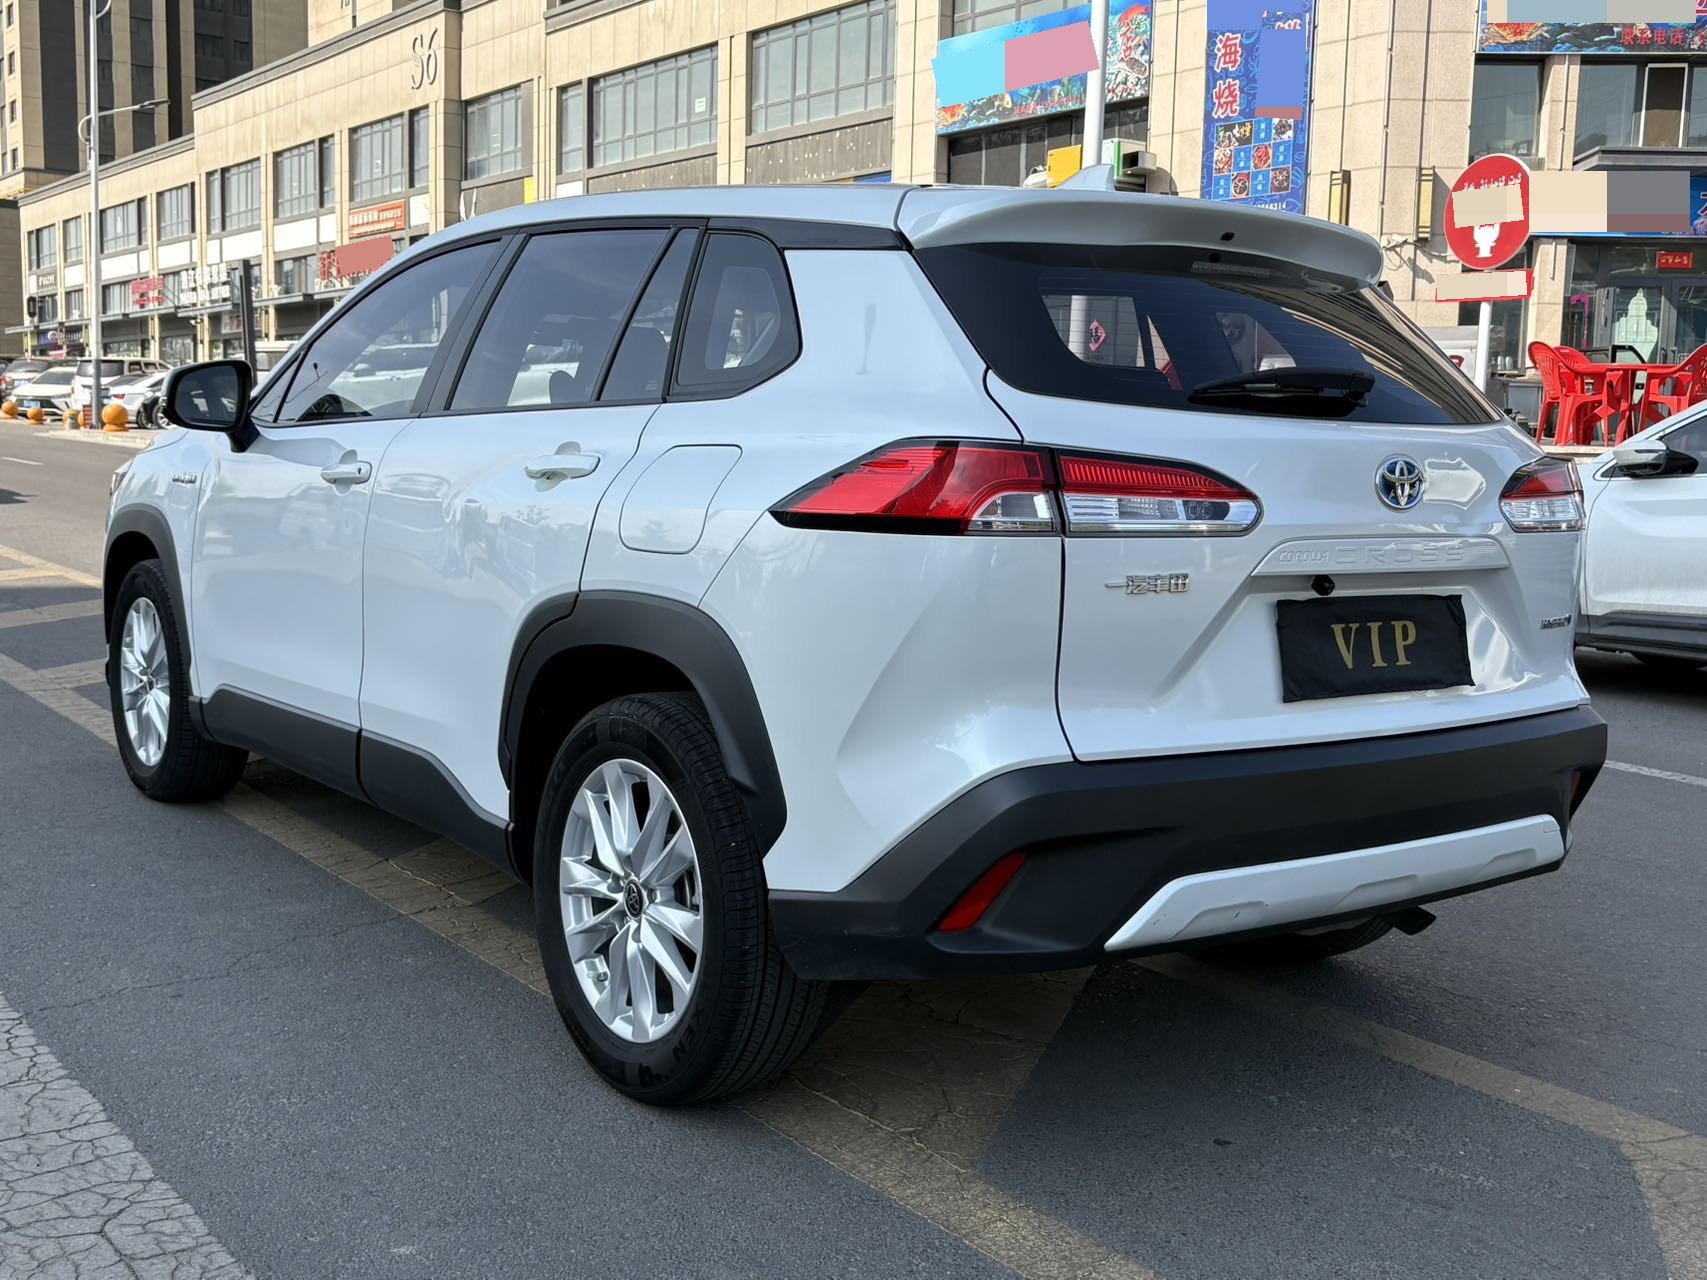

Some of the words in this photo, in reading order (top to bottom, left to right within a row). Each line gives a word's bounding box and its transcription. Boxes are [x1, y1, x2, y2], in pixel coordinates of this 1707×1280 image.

[1335, 544, 1464, 565] CROSS
[1104, 572, 1189, 595] 一汽丰田
[1330, 620, 1416, 669] VIP
